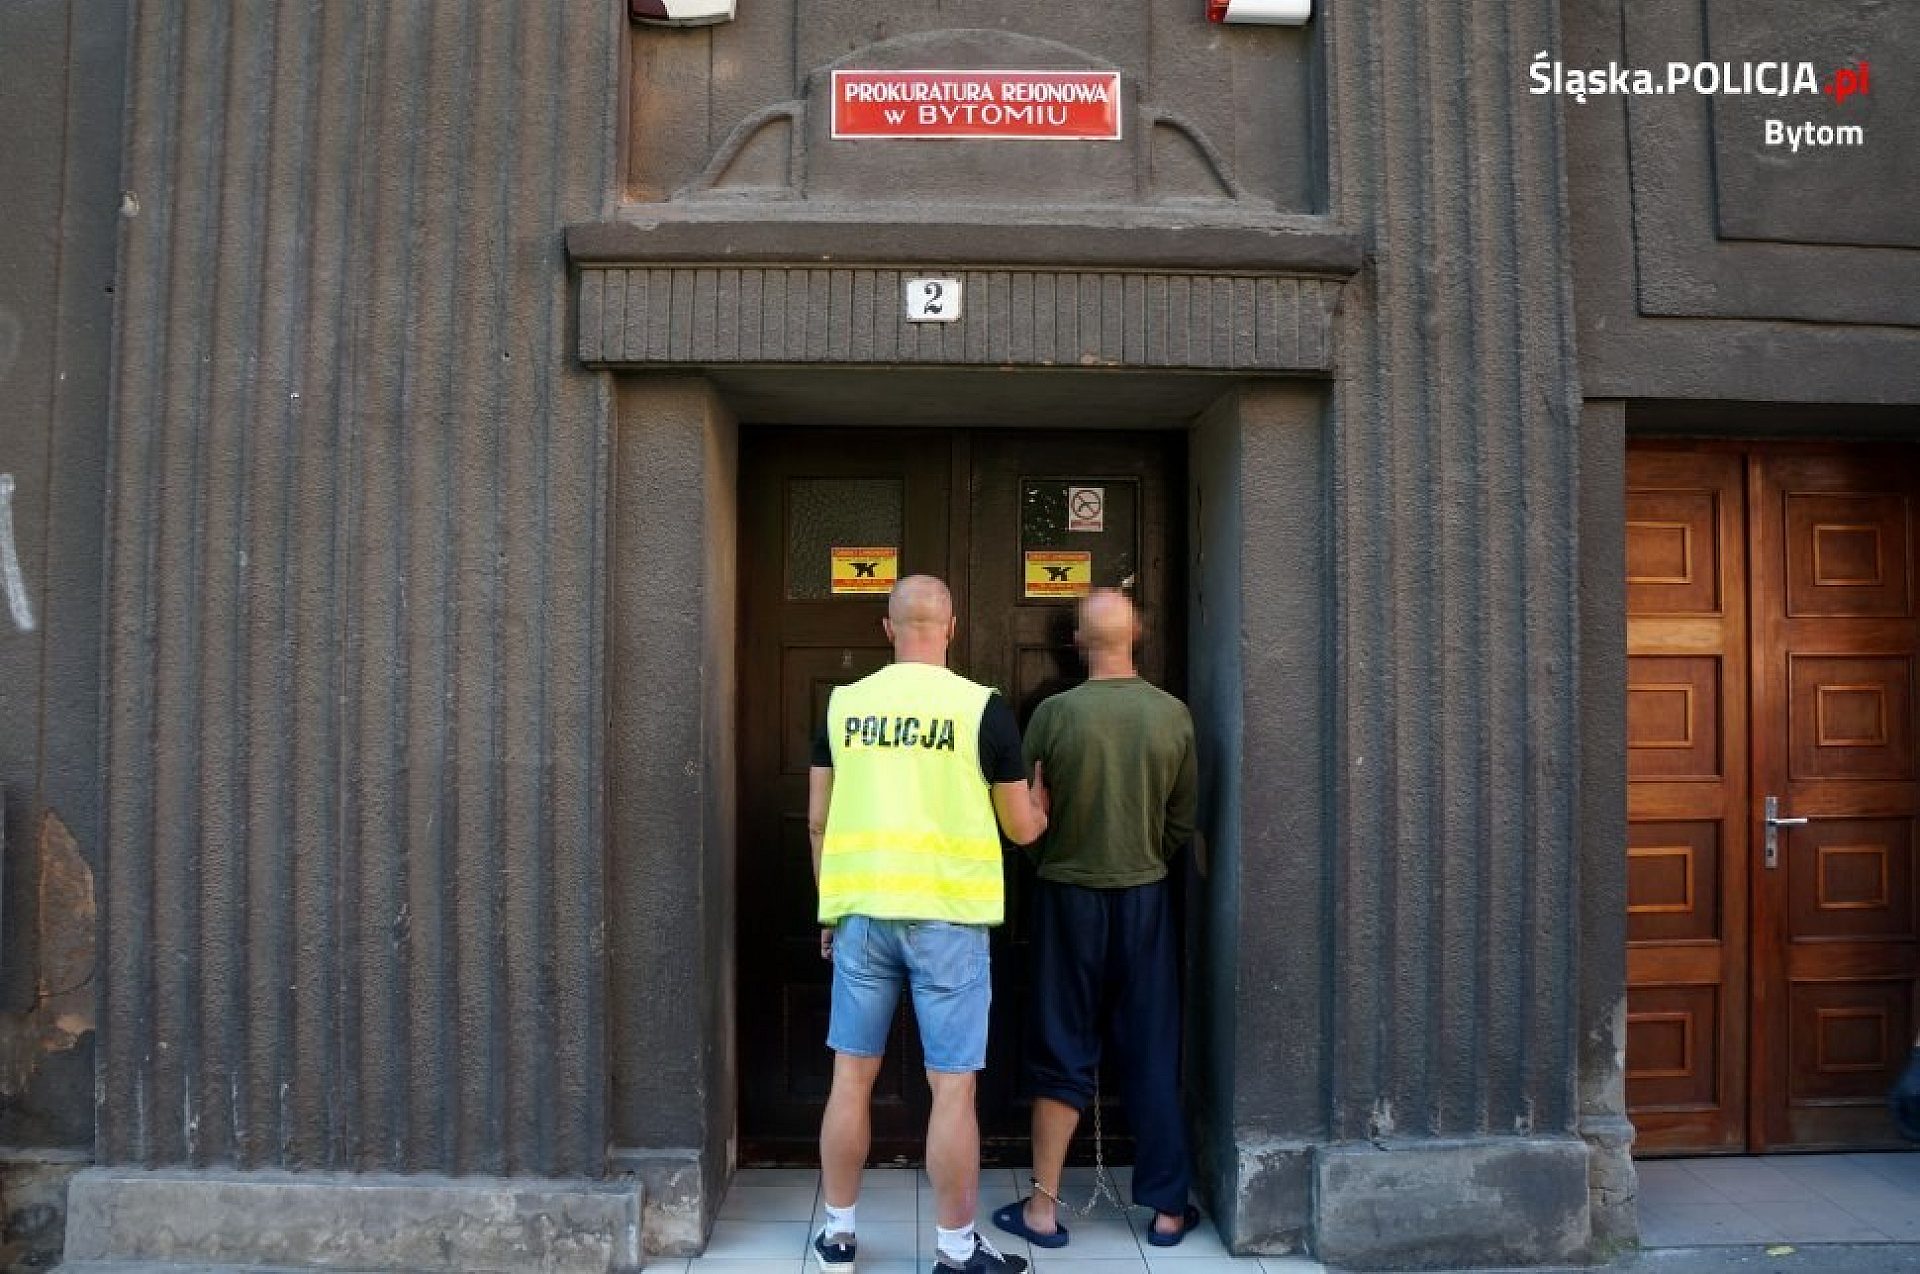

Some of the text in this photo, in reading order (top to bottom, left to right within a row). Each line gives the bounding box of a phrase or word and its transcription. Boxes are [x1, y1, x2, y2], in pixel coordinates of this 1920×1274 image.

[844, 81, 1109, 103] PROKURATURA REJONOWA
[919, 104, 1068, 125] BYTOMIU
[924, 281, 943, 315] 2
[844, 715, 955, 752] POLICJA
